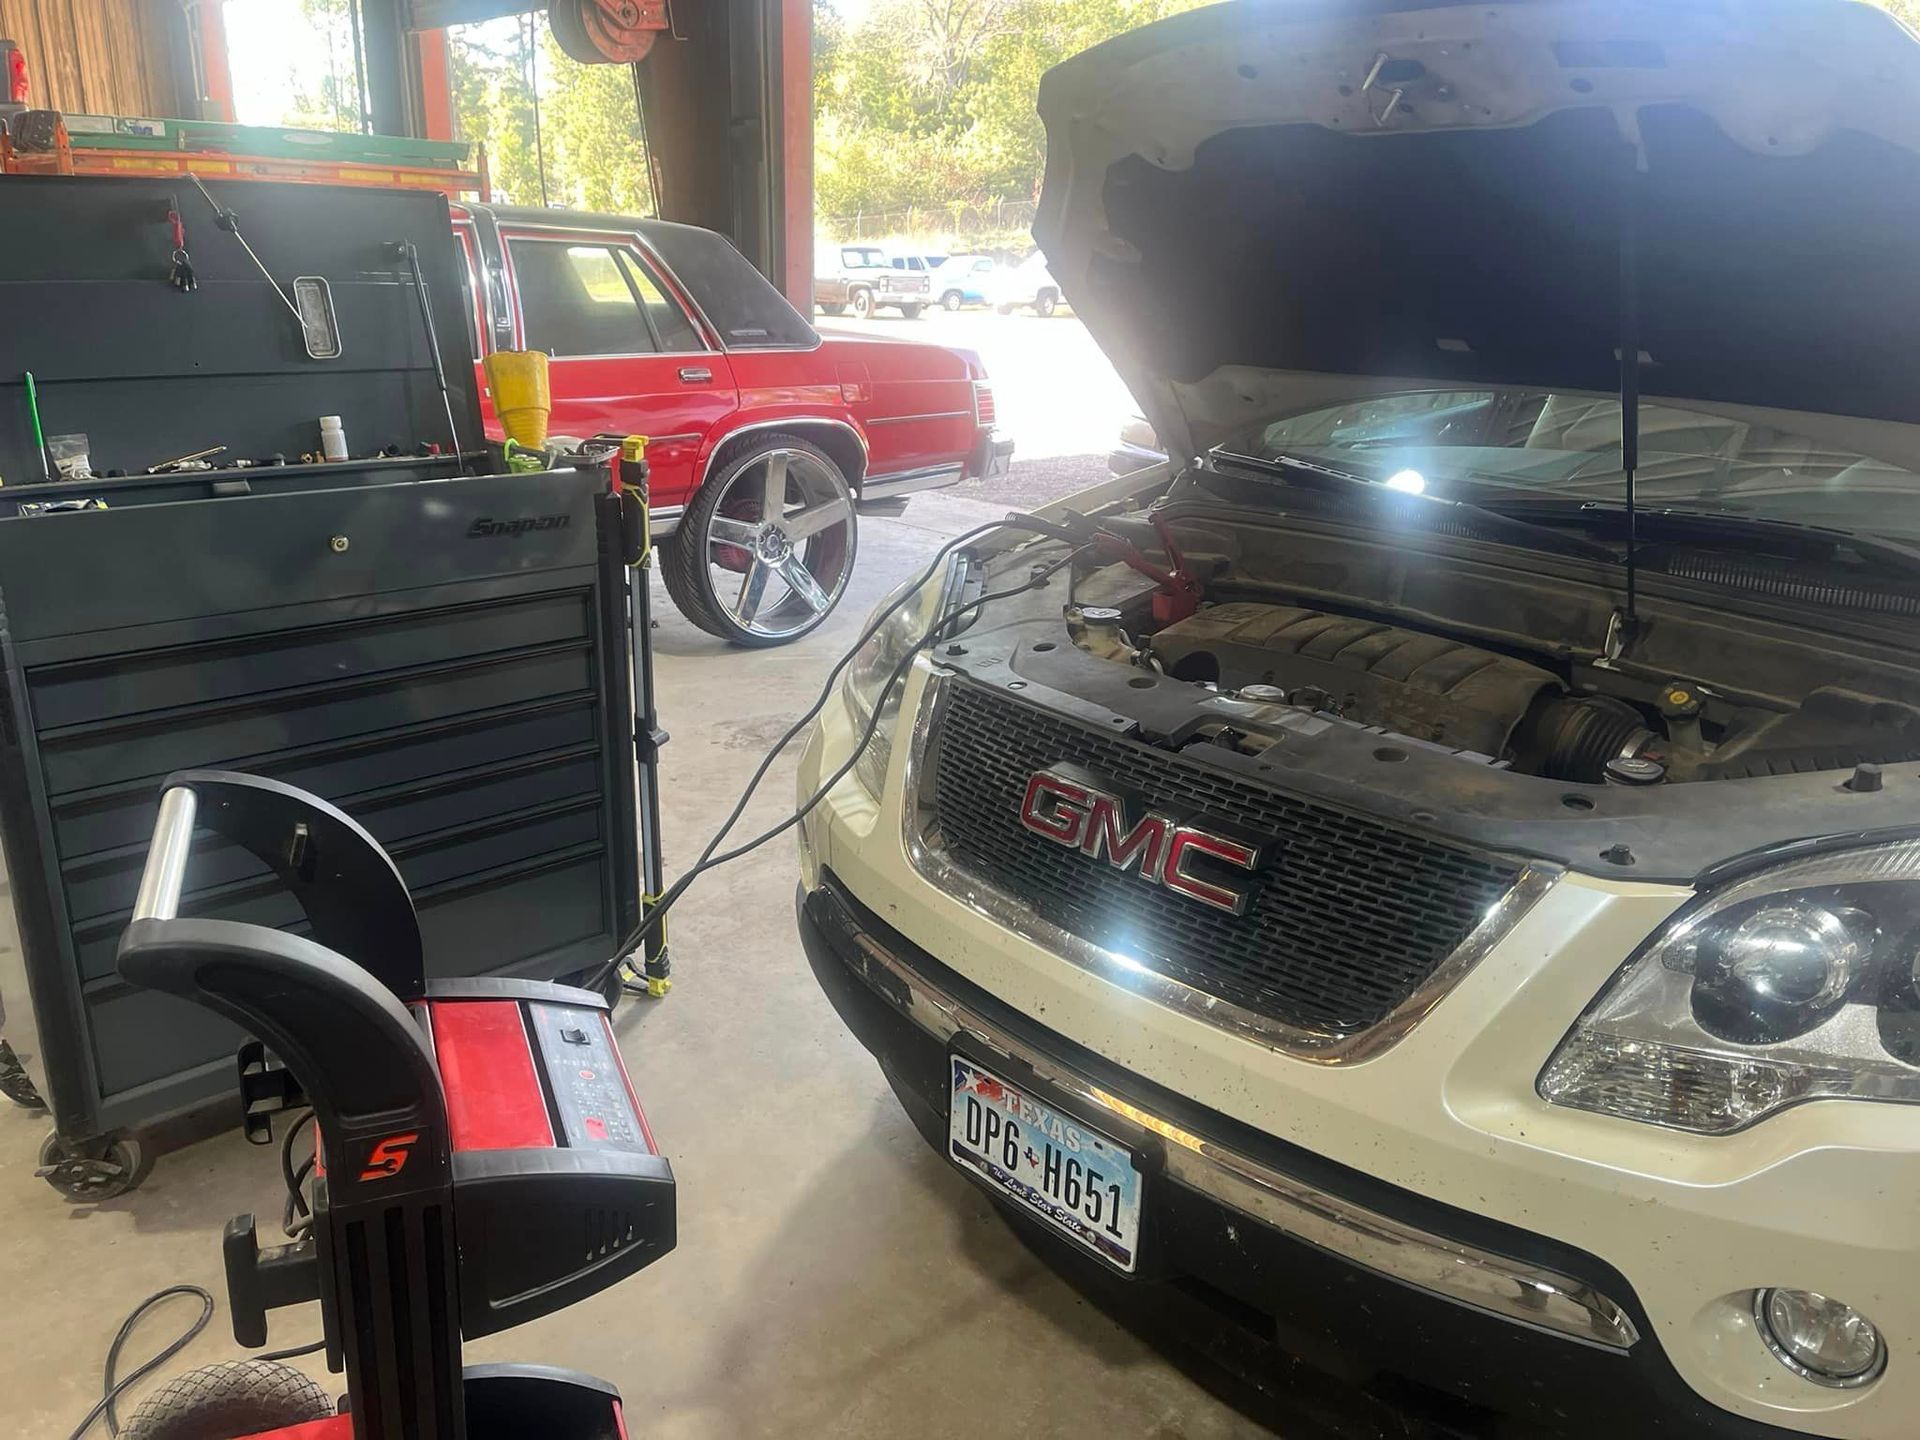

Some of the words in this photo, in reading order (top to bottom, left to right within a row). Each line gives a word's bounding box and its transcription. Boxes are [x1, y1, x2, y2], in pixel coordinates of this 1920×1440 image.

[1020, 769, 1261, 916] GMC
[966, 1095, 1020, 1171] DP6
[1043, 1142, 1123, 1239] H651
[1003, 1087, 1082, 1153] TEXAS
[1003, 1178, 1028, 1198] Lone
[1029, 1192, 1053, 1214] Star
[1054, 1208, 1082, 1233] State
